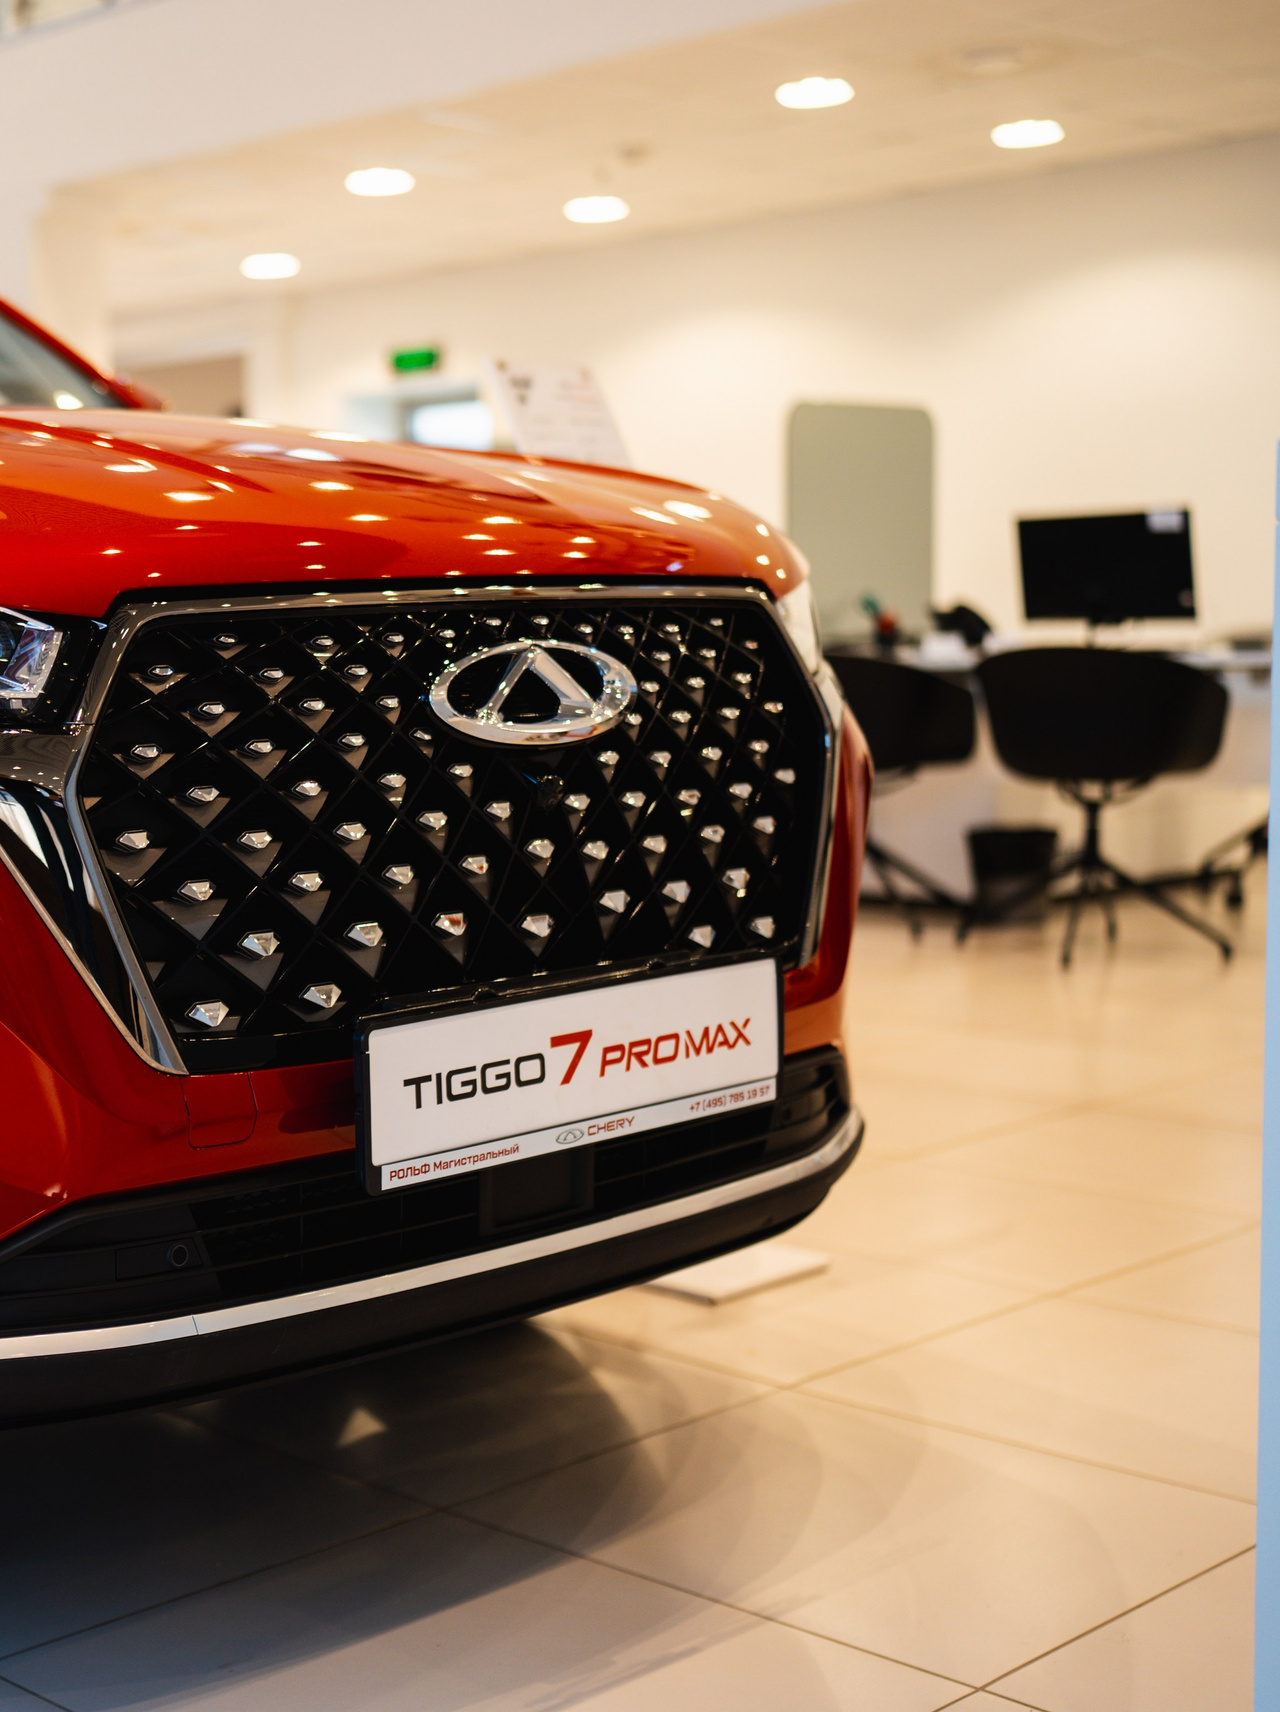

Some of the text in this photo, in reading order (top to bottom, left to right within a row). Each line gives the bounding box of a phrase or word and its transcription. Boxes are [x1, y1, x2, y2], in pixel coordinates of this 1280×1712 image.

[403, 1053, 546, 1109] TIGGO
[550, 1029, 593, 1086] 7
[689, 1085, 770, 1113] +7 (495) 785 19 57
[587, 1116, 635, 1137] CHERY
[389, 1143, 520, 1181] РОЛЬФ Магистральный
